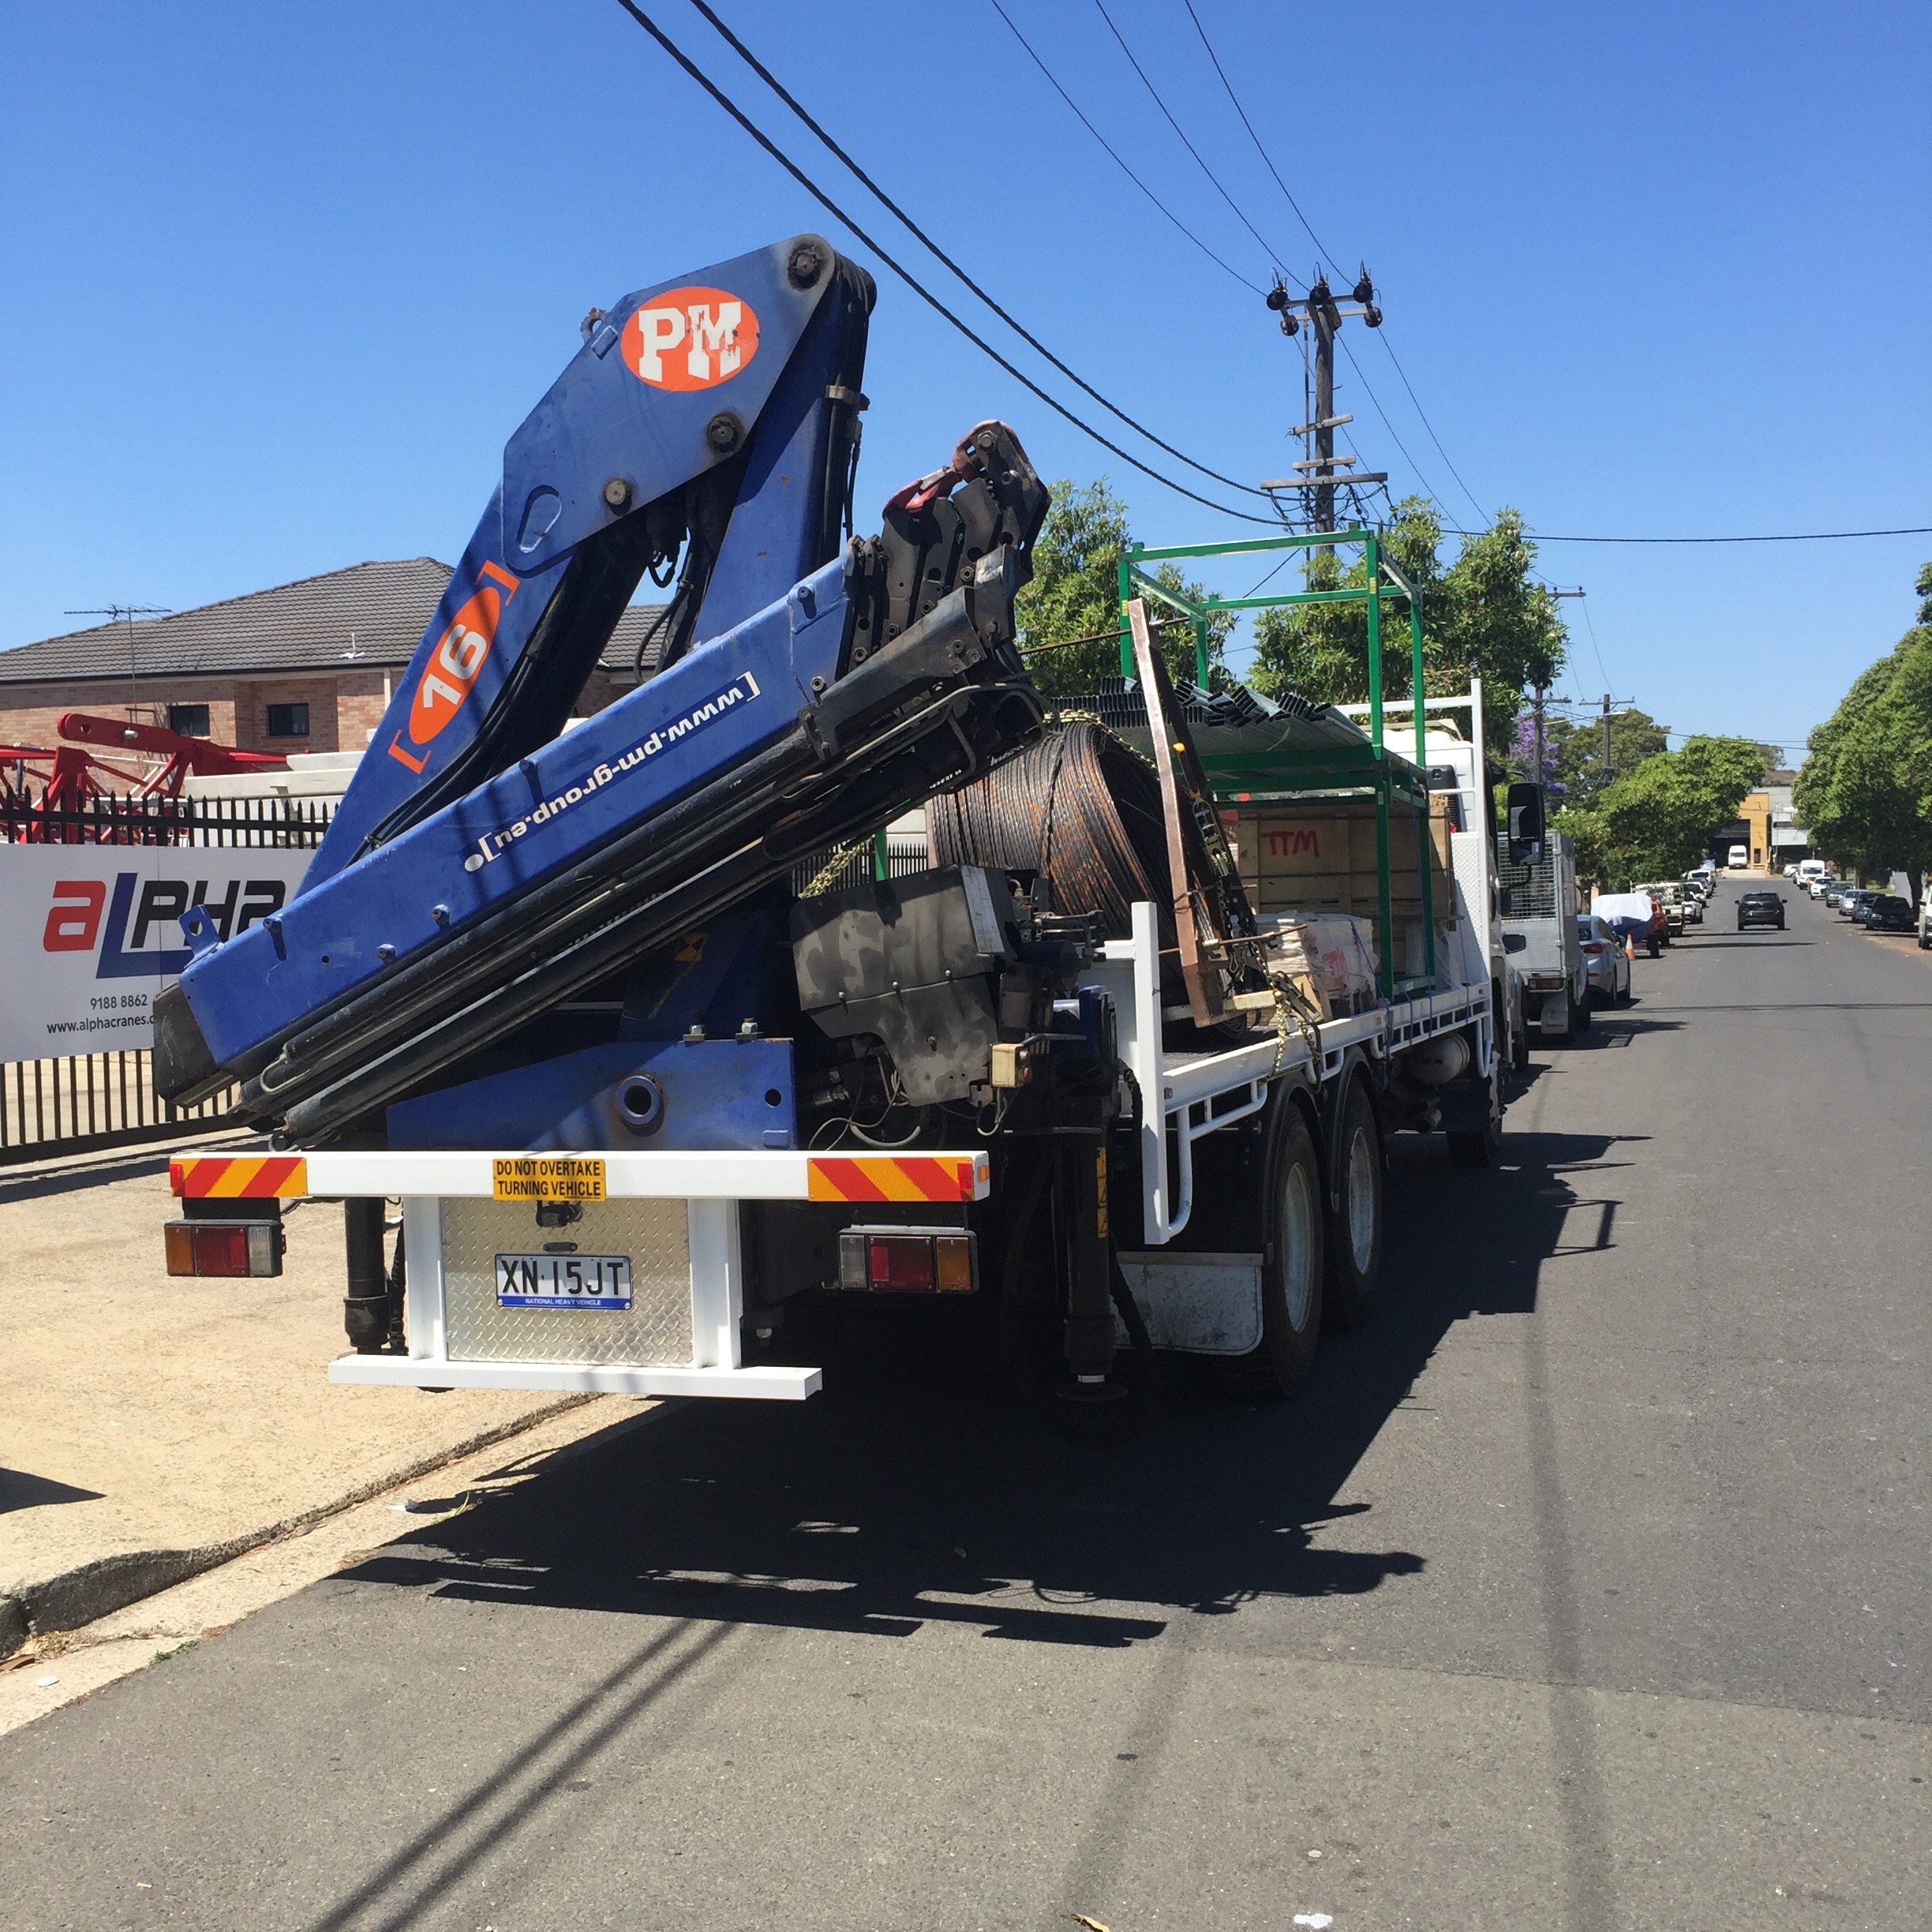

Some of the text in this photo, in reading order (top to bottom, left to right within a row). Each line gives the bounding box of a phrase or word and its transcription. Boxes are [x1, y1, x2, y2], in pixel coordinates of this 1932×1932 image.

[638, 301, 741, 383] PM
[421, 624, 489, 710] 16
[90, 994, 148, 1011] 9188 8862
[497, 1160, 601, 1177] DO NOT OVERTAKE
[497, 1180, 601, 1196] TURNING VEHICLE
